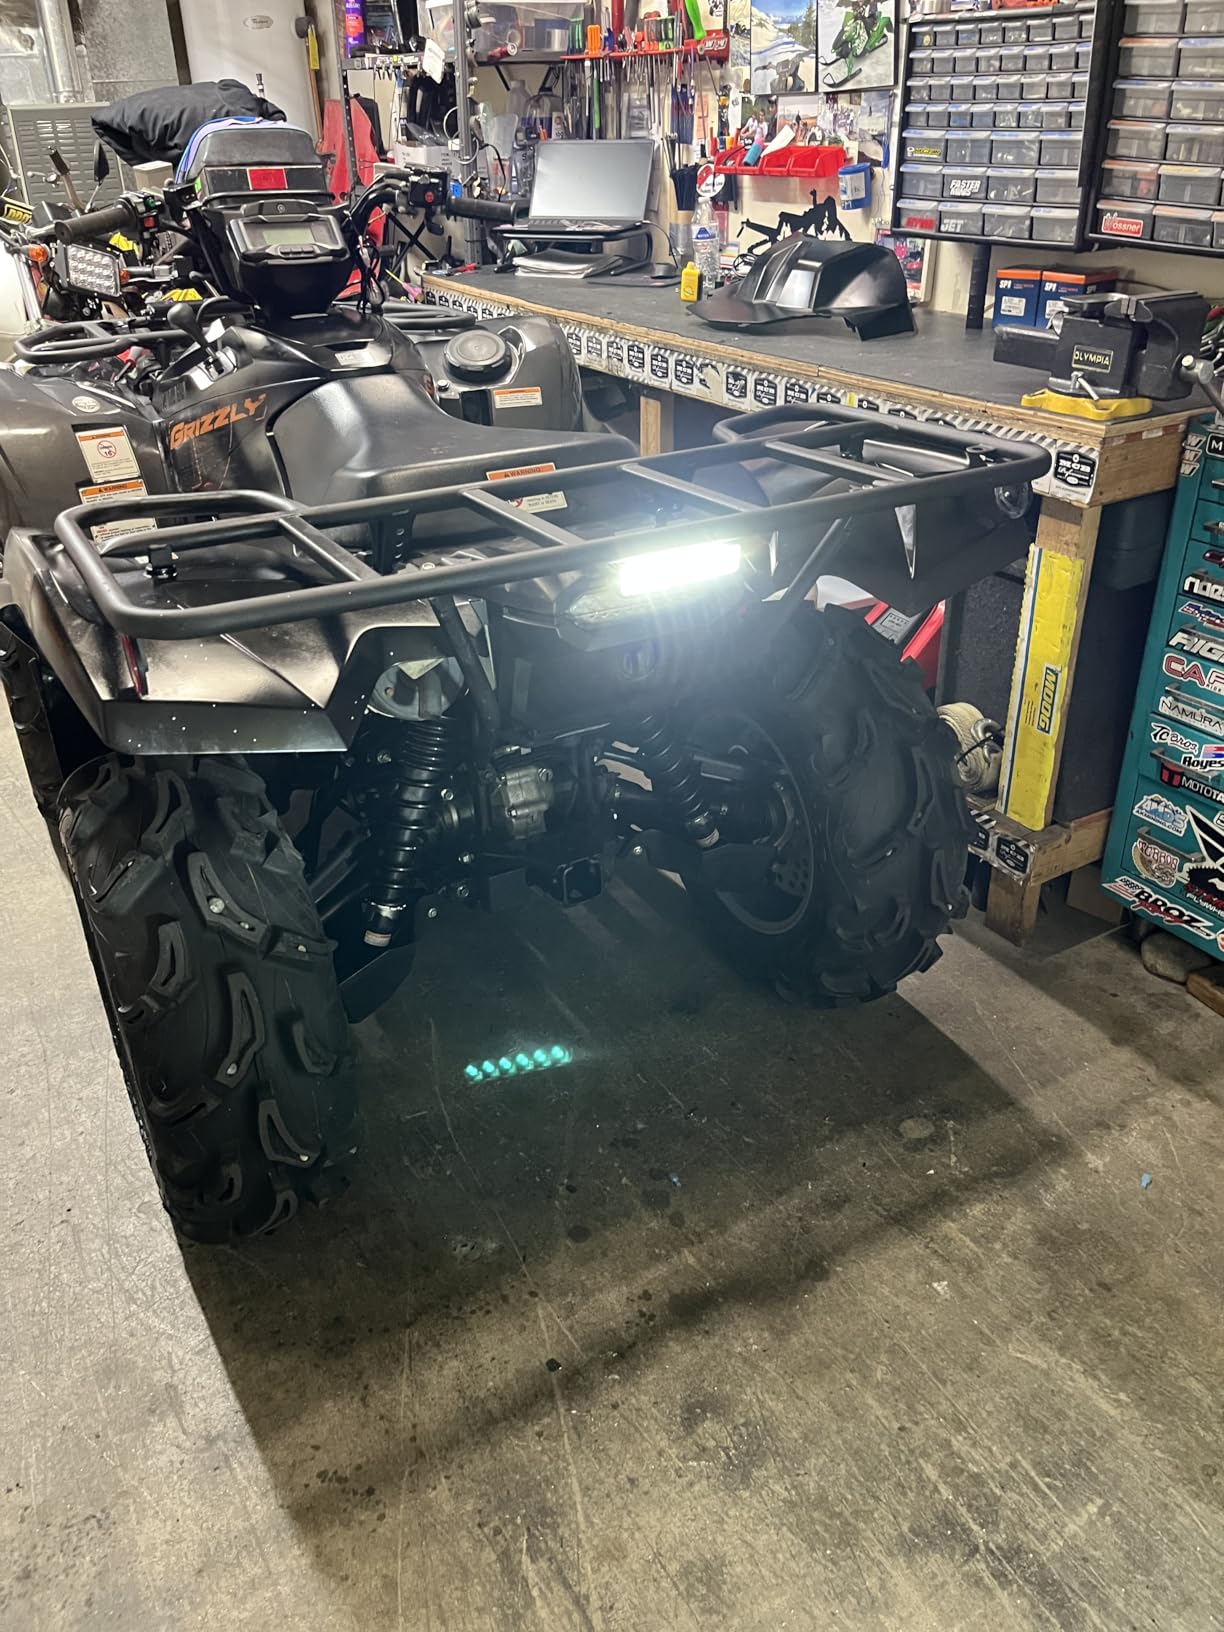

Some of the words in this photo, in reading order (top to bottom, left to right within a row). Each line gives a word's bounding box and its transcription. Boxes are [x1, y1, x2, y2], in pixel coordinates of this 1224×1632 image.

[949, 179, 981, 190] FASTER
[941, 219, 963, 232] JET
[1073, 350, 1110, 365] OLYMPIA
[169, 393, 267, 450] GRIZZLY
[510, 466, 541, 478] WARNING
[1039, 668, 1057, 732] MOOG
[1161, 700, 1223, 730] NAMURA
